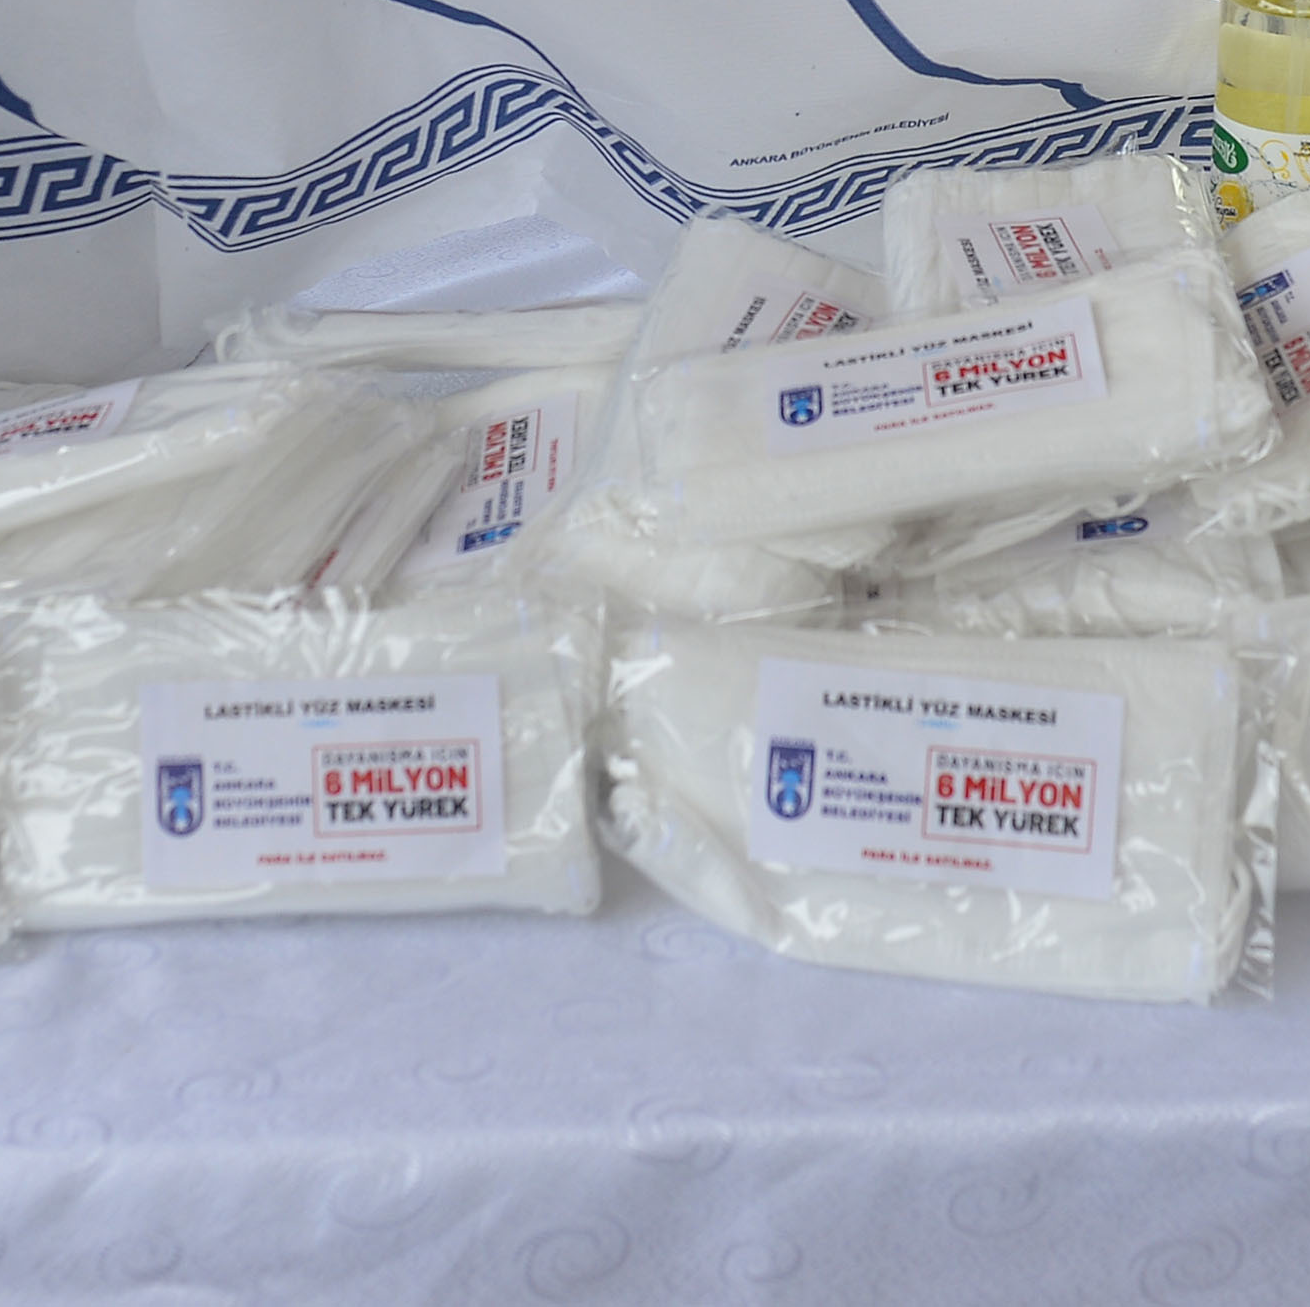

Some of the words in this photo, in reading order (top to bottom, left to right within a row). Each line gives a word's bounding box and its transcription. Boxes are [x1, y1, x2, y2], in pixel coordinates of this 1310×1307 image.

[730, 153, 788, 168] ANKARA
[873, 112, 950, 134] BELEDİYESİ
[933, 370, 951, 383] 6
[935, 380, 983, 398] TEK
[204, 699, 295, 721] LASTİKLİ
[300, 697, 341, 717] YÜZ
[344, 693, 436, 714] MASKESİ
[822, 691, 915, 714] LASTİKLİ
[921, 698, 960, 719] YÜZ
[965, 704, 1058, 727] MASKESİ
[323, 768, 345, 795] 6
[936, 774, 955, 799] 6
[325, 799, 376, 824] TEK
[935, 805, 985, 829] TEK
